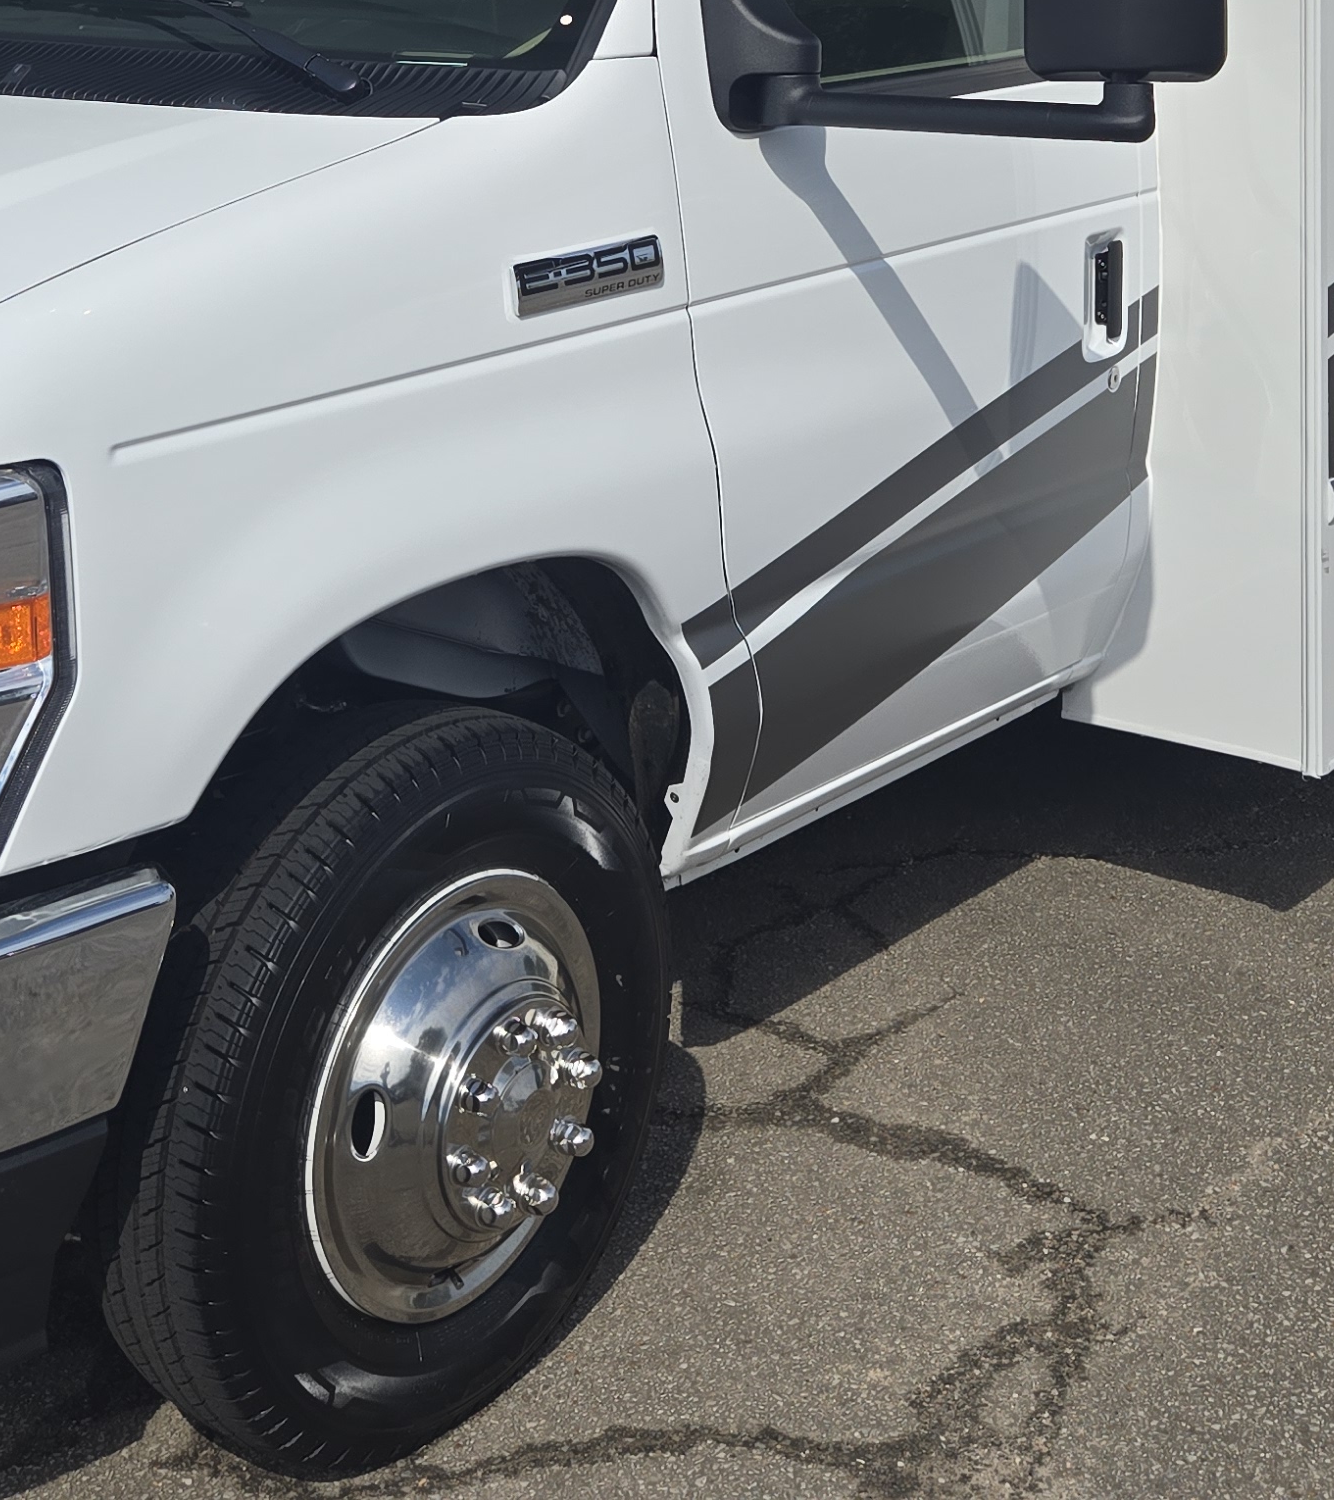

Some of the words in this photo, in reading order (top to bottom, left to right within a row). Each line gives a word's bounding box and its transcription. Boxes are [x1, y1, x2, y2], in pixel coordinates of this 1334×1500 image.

[517, 237, 662, 297] E-350
[584, 281, 625, 298] SUPER
[627, 273, 661, 290] DUTY
